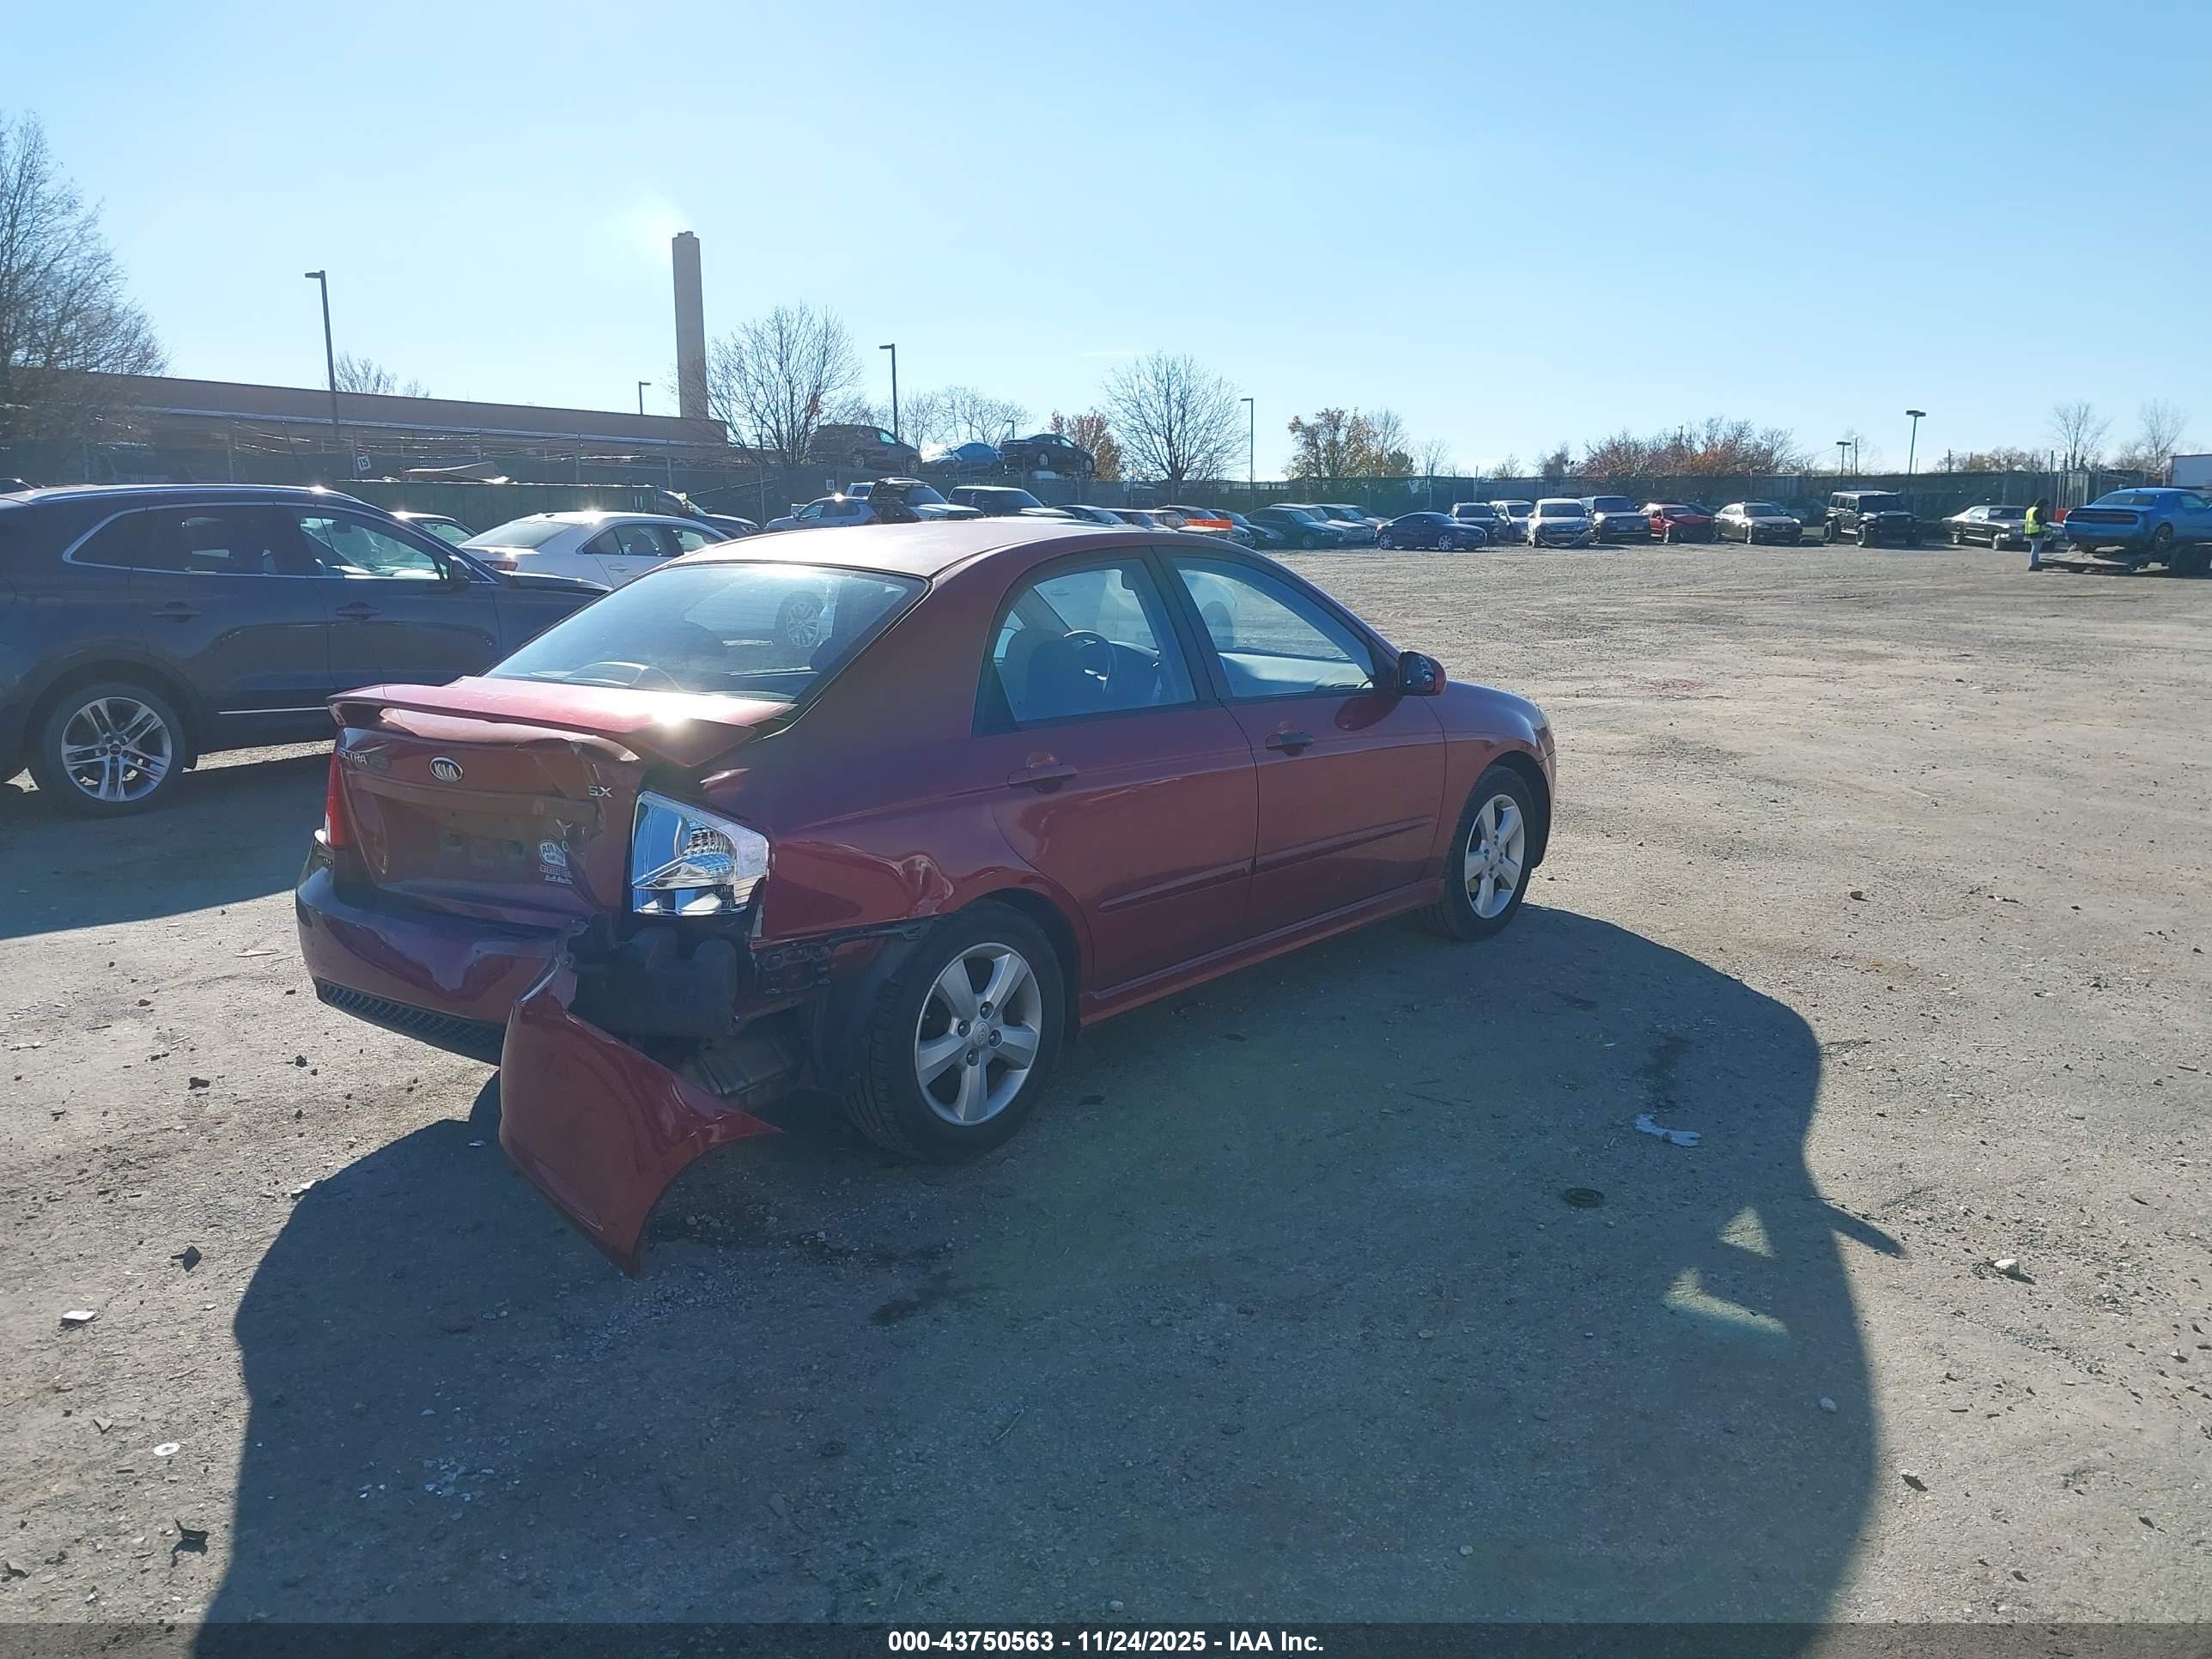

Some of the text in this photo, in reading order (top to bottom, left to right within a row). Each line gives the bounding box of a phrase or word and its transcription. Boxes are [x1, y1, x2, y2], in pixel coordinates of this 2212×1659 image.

[359, 459, 369, 468] 15
[434, 763, 458, 778] KIA
[588, 785, 613, 798] SX
